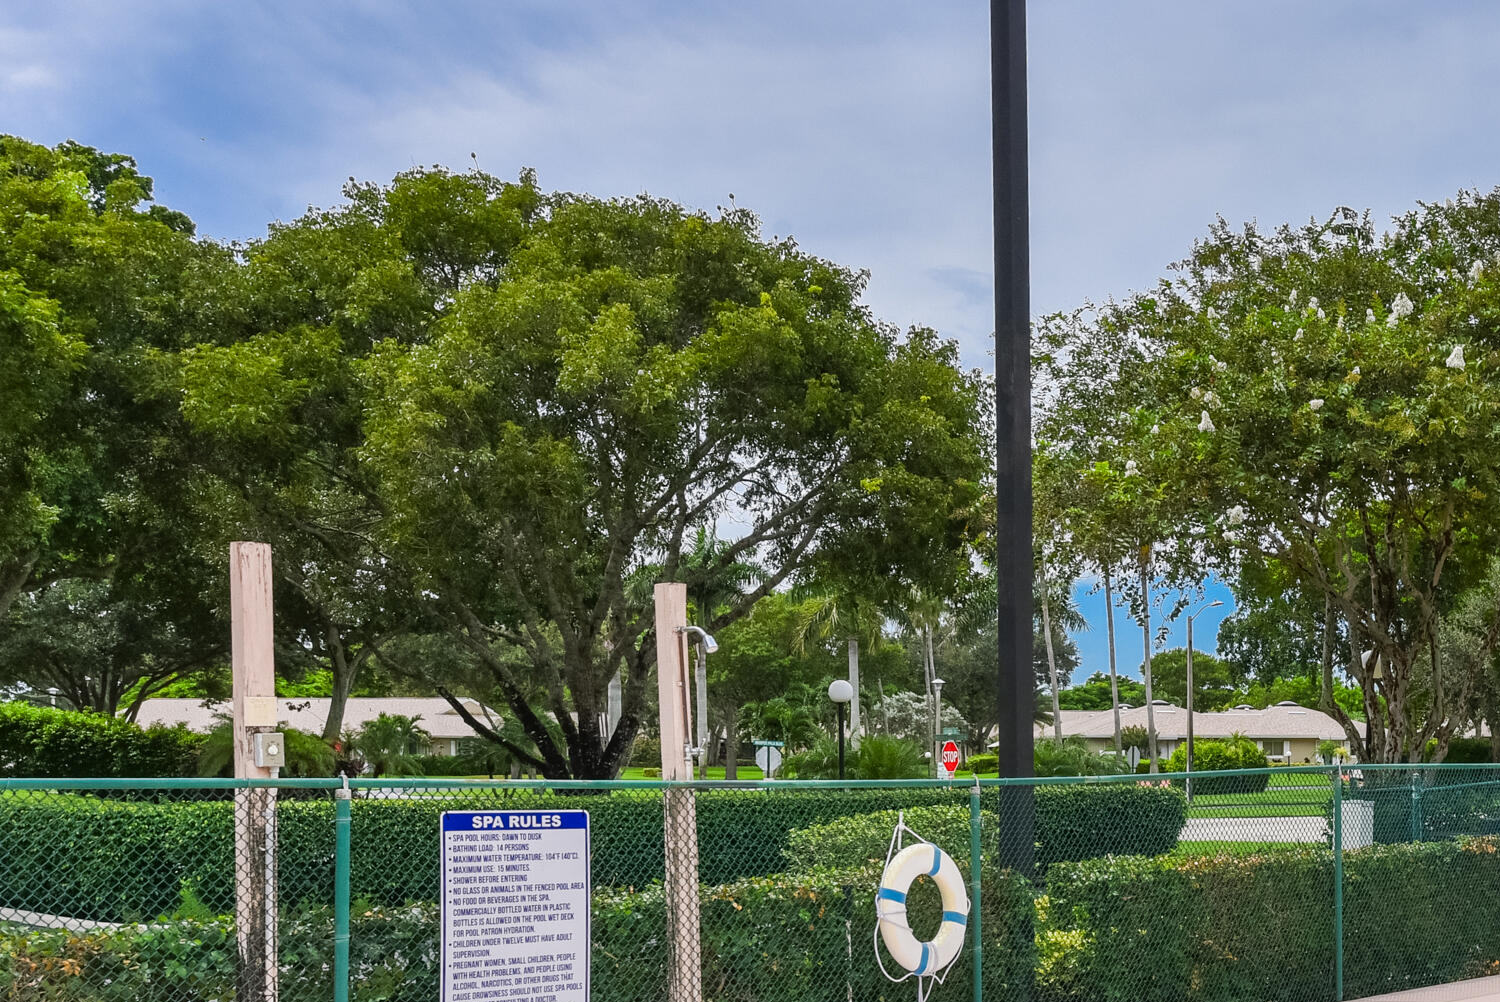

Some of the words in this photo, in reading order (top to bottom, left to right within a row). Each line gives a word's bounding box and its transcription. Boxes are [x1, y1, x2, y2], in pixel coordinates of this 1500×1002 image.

[943, 751, 958, 762] STOP
[472, 816, 504, 828] SPA
[509, 815, 561, 827] RULES
[487, 896, 519, 904] BEVERAGES
[453, 908, 496, 916] COMMERCIALLY
[453, 940, 481, 948] CHILDREN
[482, 939, 501, 947] UNDER
[453, 960, 482, 969] PREGNANT
[508, 957, 526, 965] SMALL
[469, 971, 490, 979] HEALTH
[473, 990, 508, 999] DROWSINESS
[510, 988, 530, 996] SHOULD
